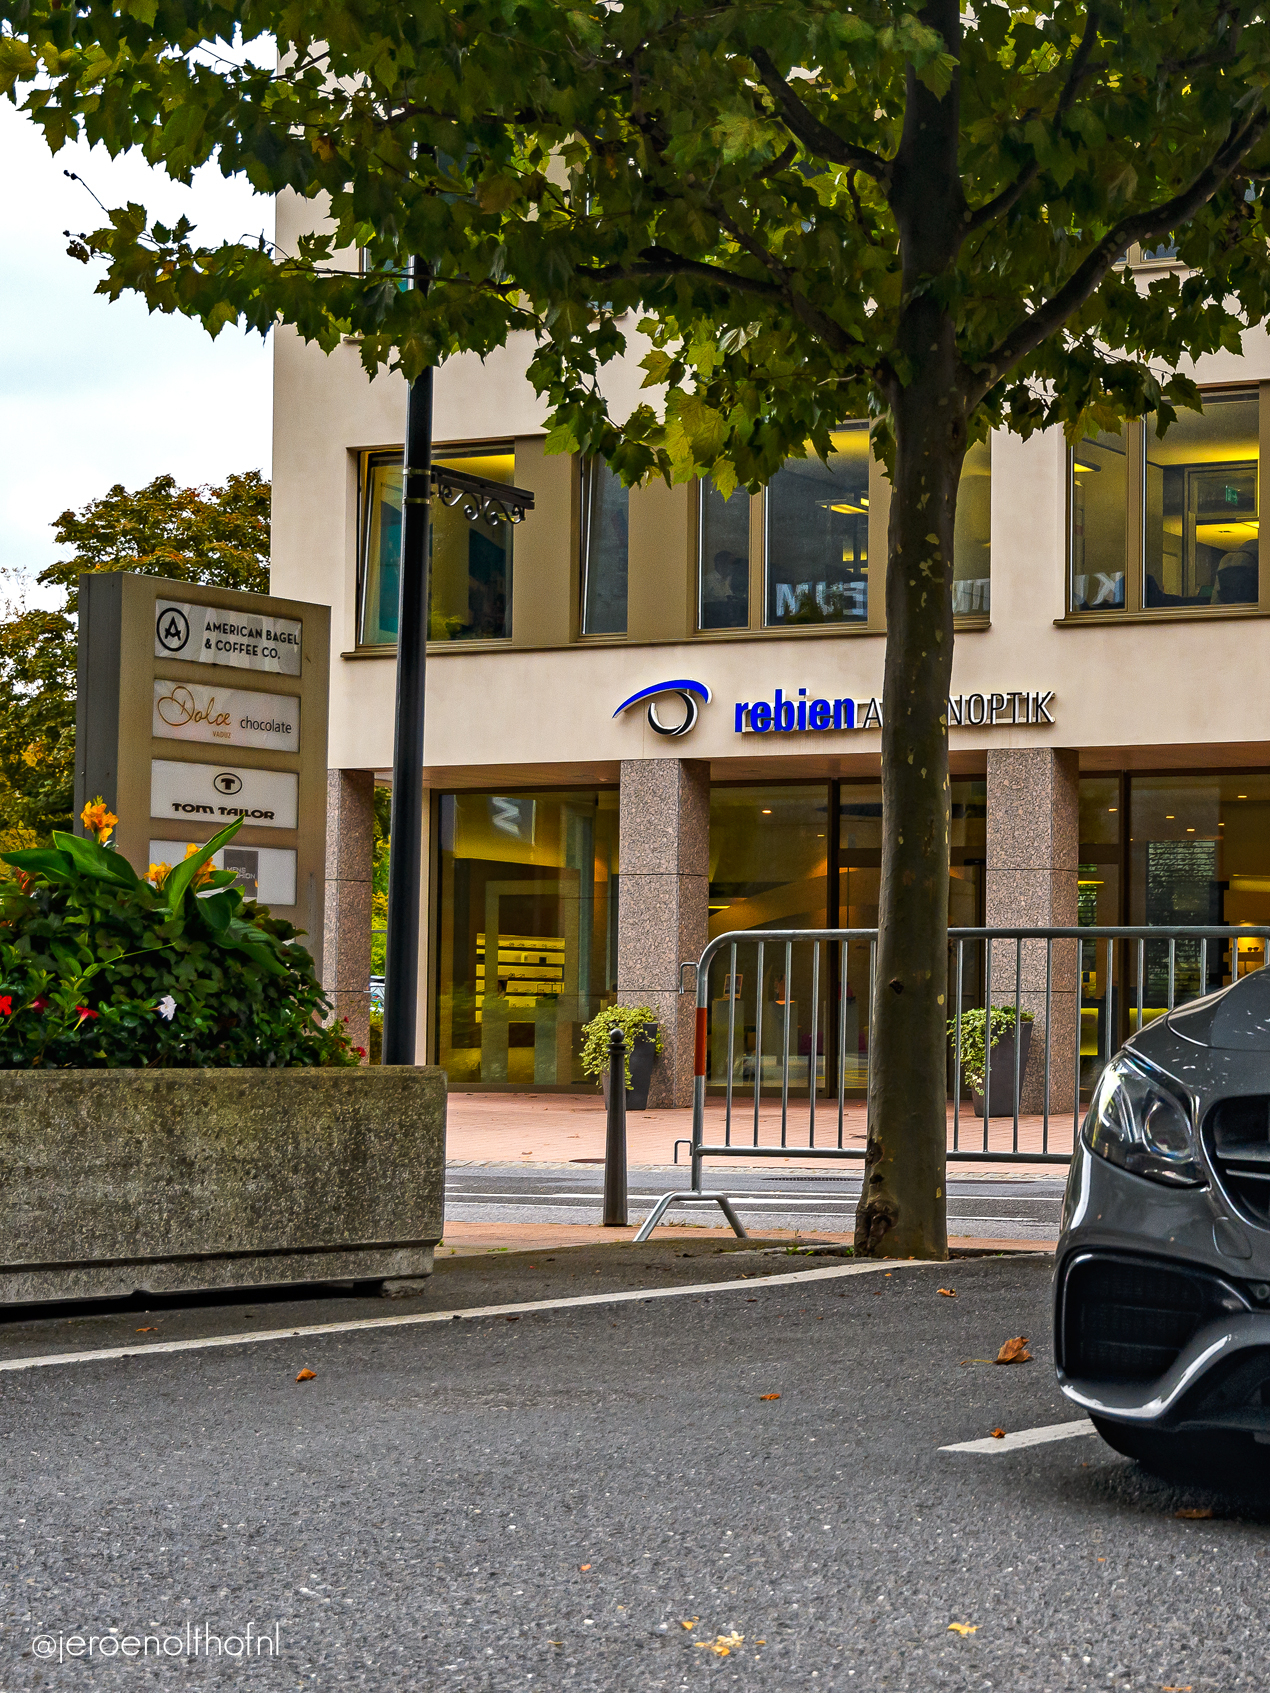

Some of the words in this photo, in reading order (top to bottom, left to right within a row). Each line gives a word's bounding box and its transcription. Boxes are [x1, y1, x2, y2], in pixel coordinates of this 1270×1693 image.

[205, 621, 263, 640] AMERICAN
[265, 629, 300, 646] BAGEL
[204, 638, 212, 650] &
[215, 639, 259, 657] COFFEE
[261, 646, 281, 660] CO.
[157, 685, 232, 727] Dolce
[734, 688, 855, 733] rebien
[862, 690, 1056, 729] ANOPTIK
[240, 716, 292, 735] chocolate
[172, 802, 214, 814] TOM
[217, 806, 275, 820] TAILOR
